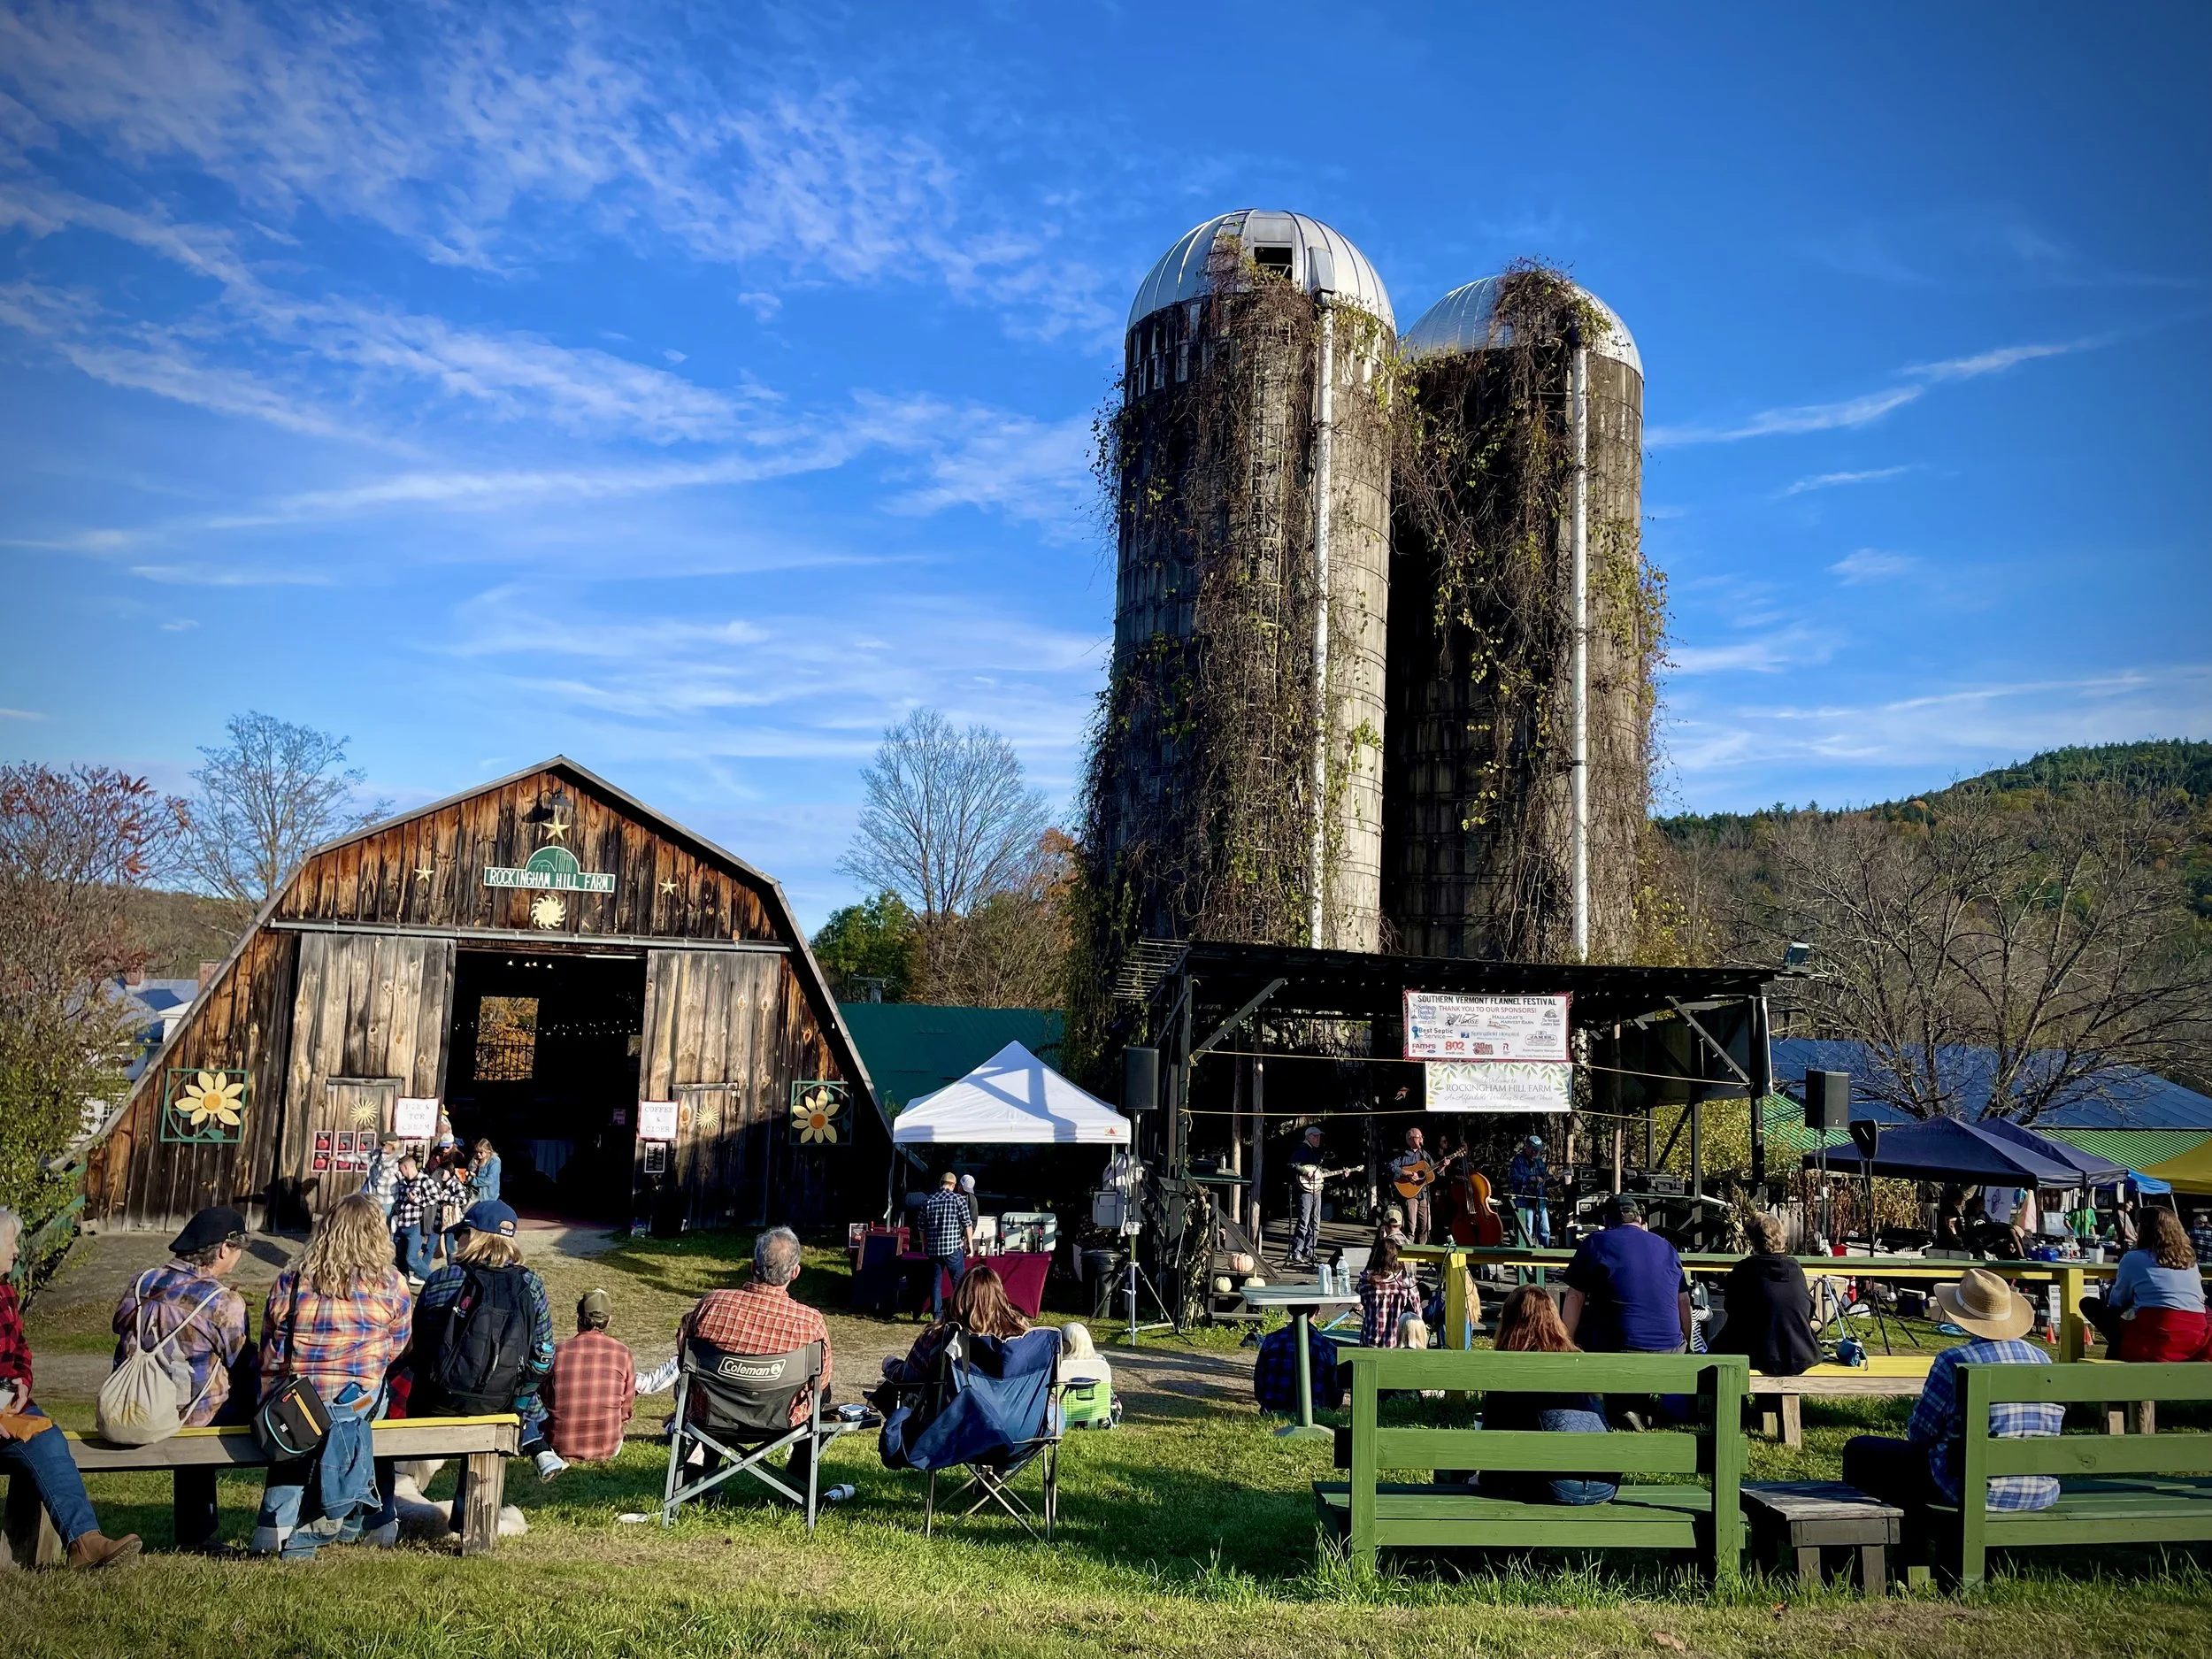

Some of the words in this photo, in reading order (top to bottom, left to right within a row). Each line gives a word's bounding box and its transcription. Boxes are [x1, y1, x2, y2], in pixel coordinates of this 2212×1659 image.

[489, 870, 551, 887] ROCKINGHAM
[556, 872, 580, 889] HILL
[584, 874, 609, 891] FARM
[1417, 995, 1453, 1003] SOUTHERN
[1445, 1041, 1465, 1051] 802
[1446, 1083, 1507, 1093] ROCKINGHAM
[1509, 1084, 1526, 1093] HILL
[1528, 1084, 1552, 1093] FARM
[724, 1360, 771, 1376] Coleman
